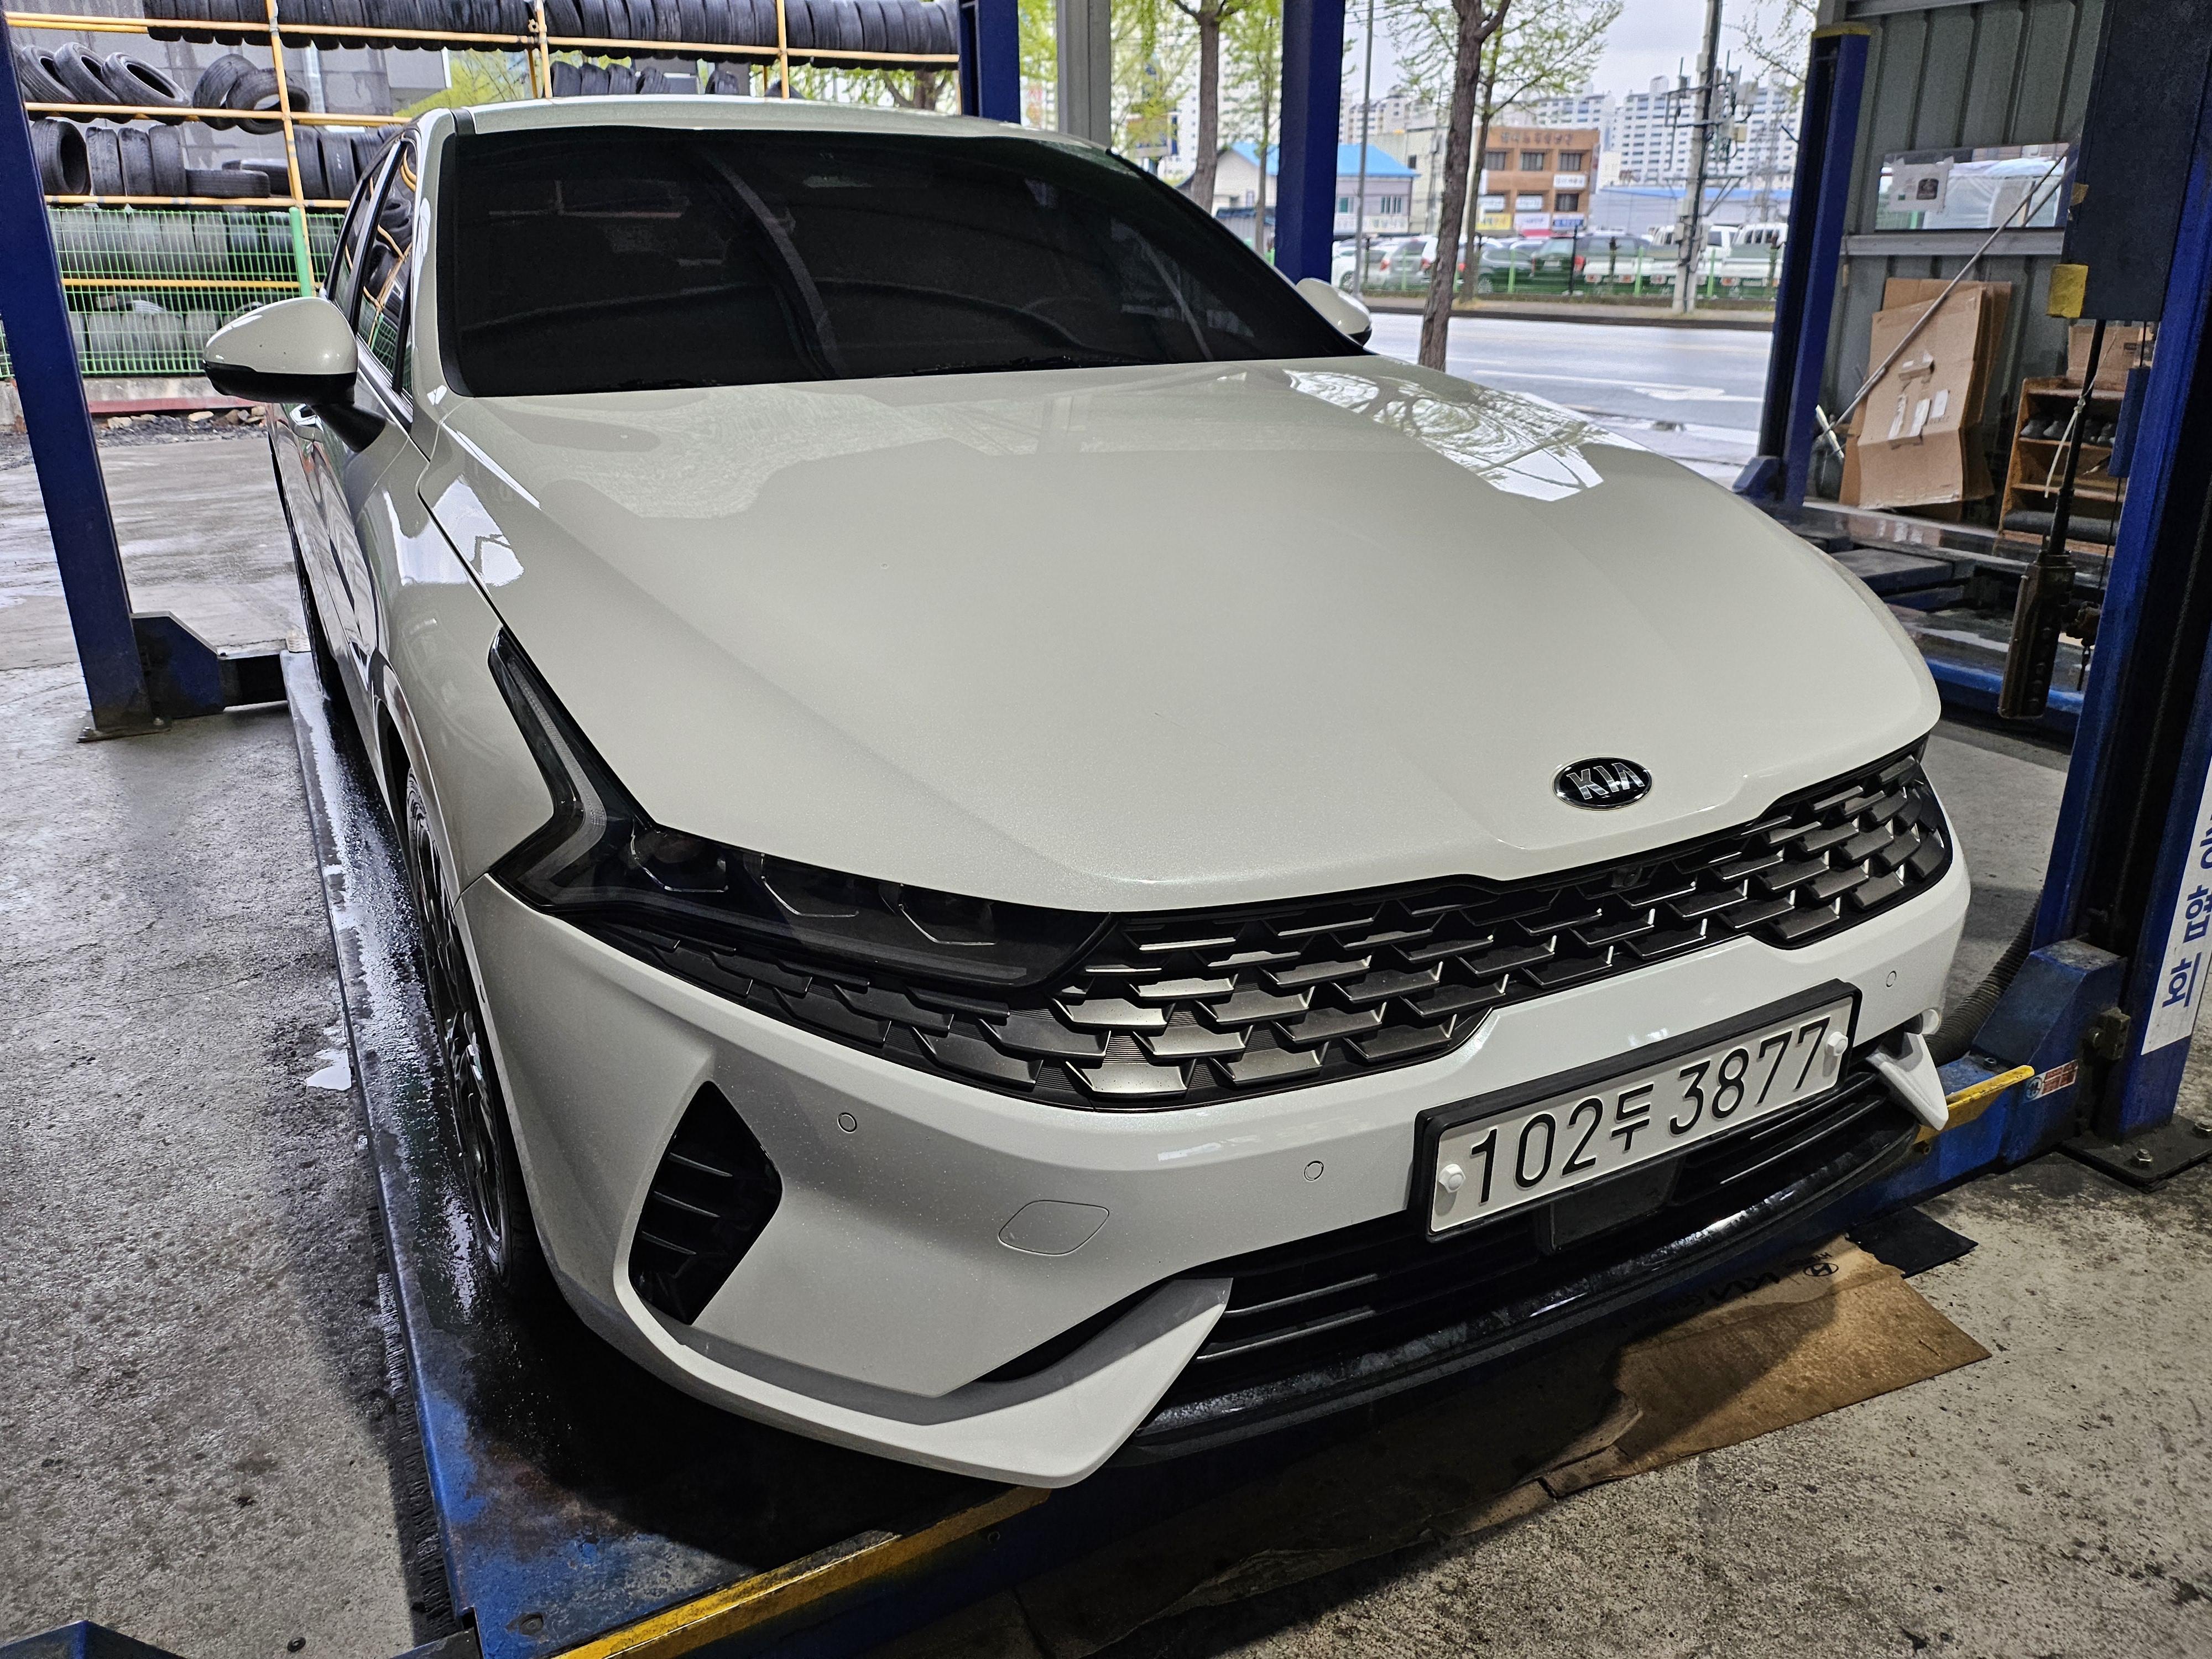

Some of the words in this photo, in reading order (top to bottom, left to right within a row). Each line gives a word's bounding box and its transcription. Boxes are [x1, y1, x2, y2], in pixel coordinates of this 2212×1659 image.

[1566, 762, 1646, 800] KIA
[1470, 1082, 1655, 1205] 102두
[1669, 1016, 1832, 1136] 3877
